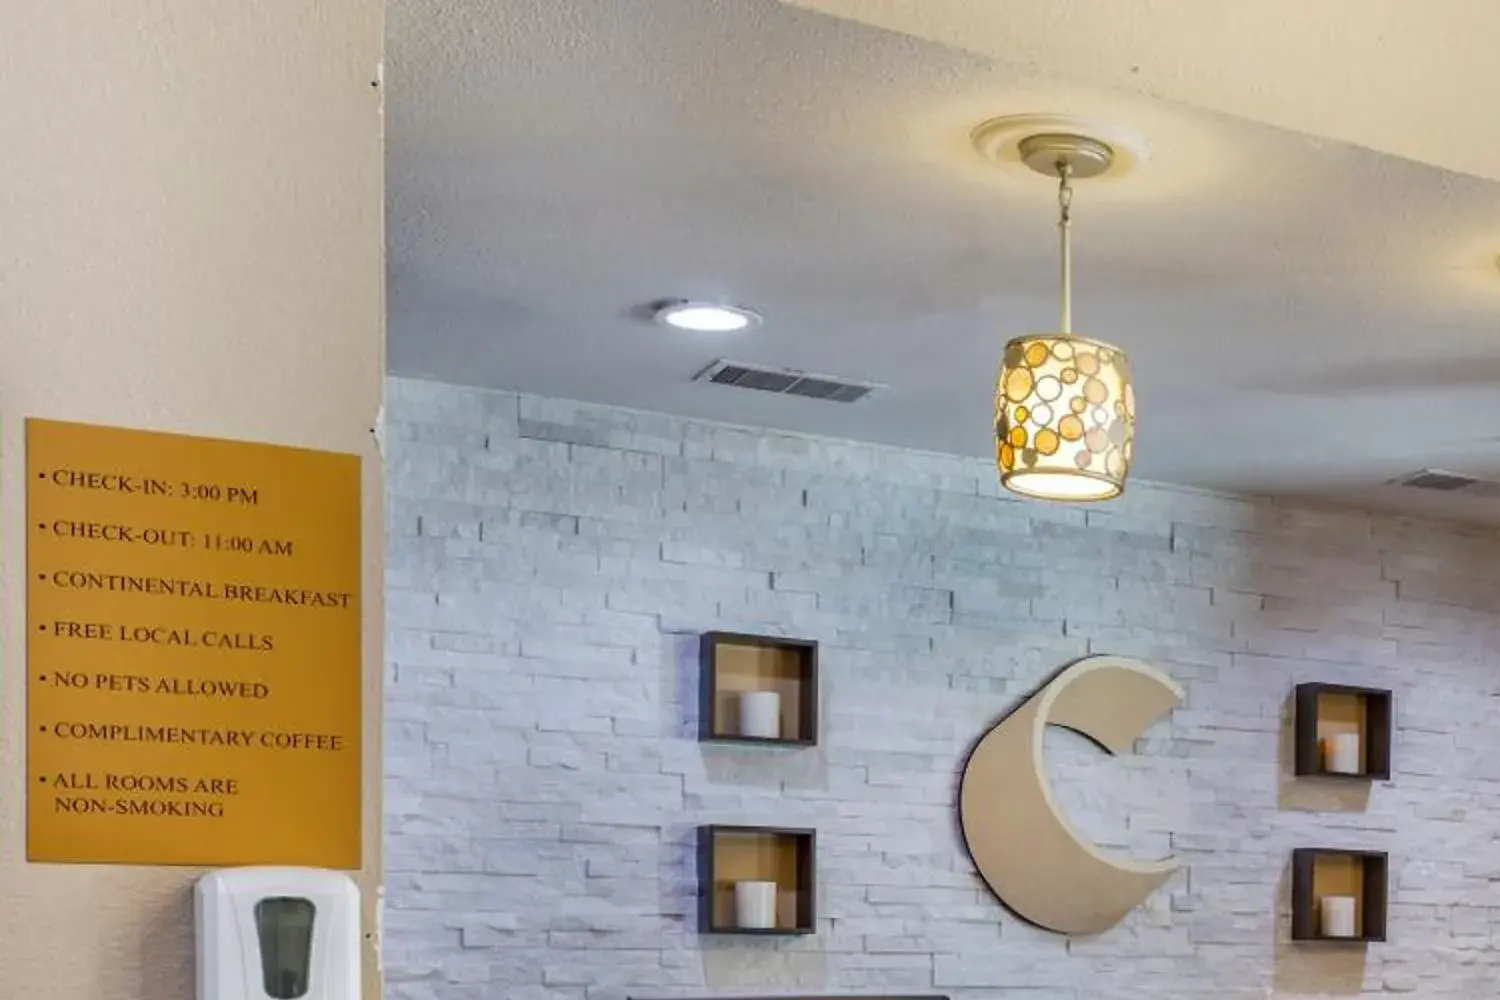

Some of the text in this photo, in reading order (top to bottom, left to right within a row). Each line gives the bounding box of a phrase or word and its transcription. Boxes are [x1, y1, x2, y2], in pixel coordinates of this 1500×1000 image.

[52, 469, 258, 505] CHECK-IN: 3:00 PM
[53, 520, 293, 557] CHECK-OUT: 11:00 AM
[53, 571, 352, 609] CONTINENTAL BREAKFAST
[54, 621, 274, 651] FREE LOCAL CALLS
[54, 671, 269, 699] NO PETS ALLOWED
[54, 722, 342, 751] COMPLIMENTARY COFFEE
[53, 773, 238, 796] ALL ROOMS ARE
[55, 797, 224, 818] NON-SMOKING
